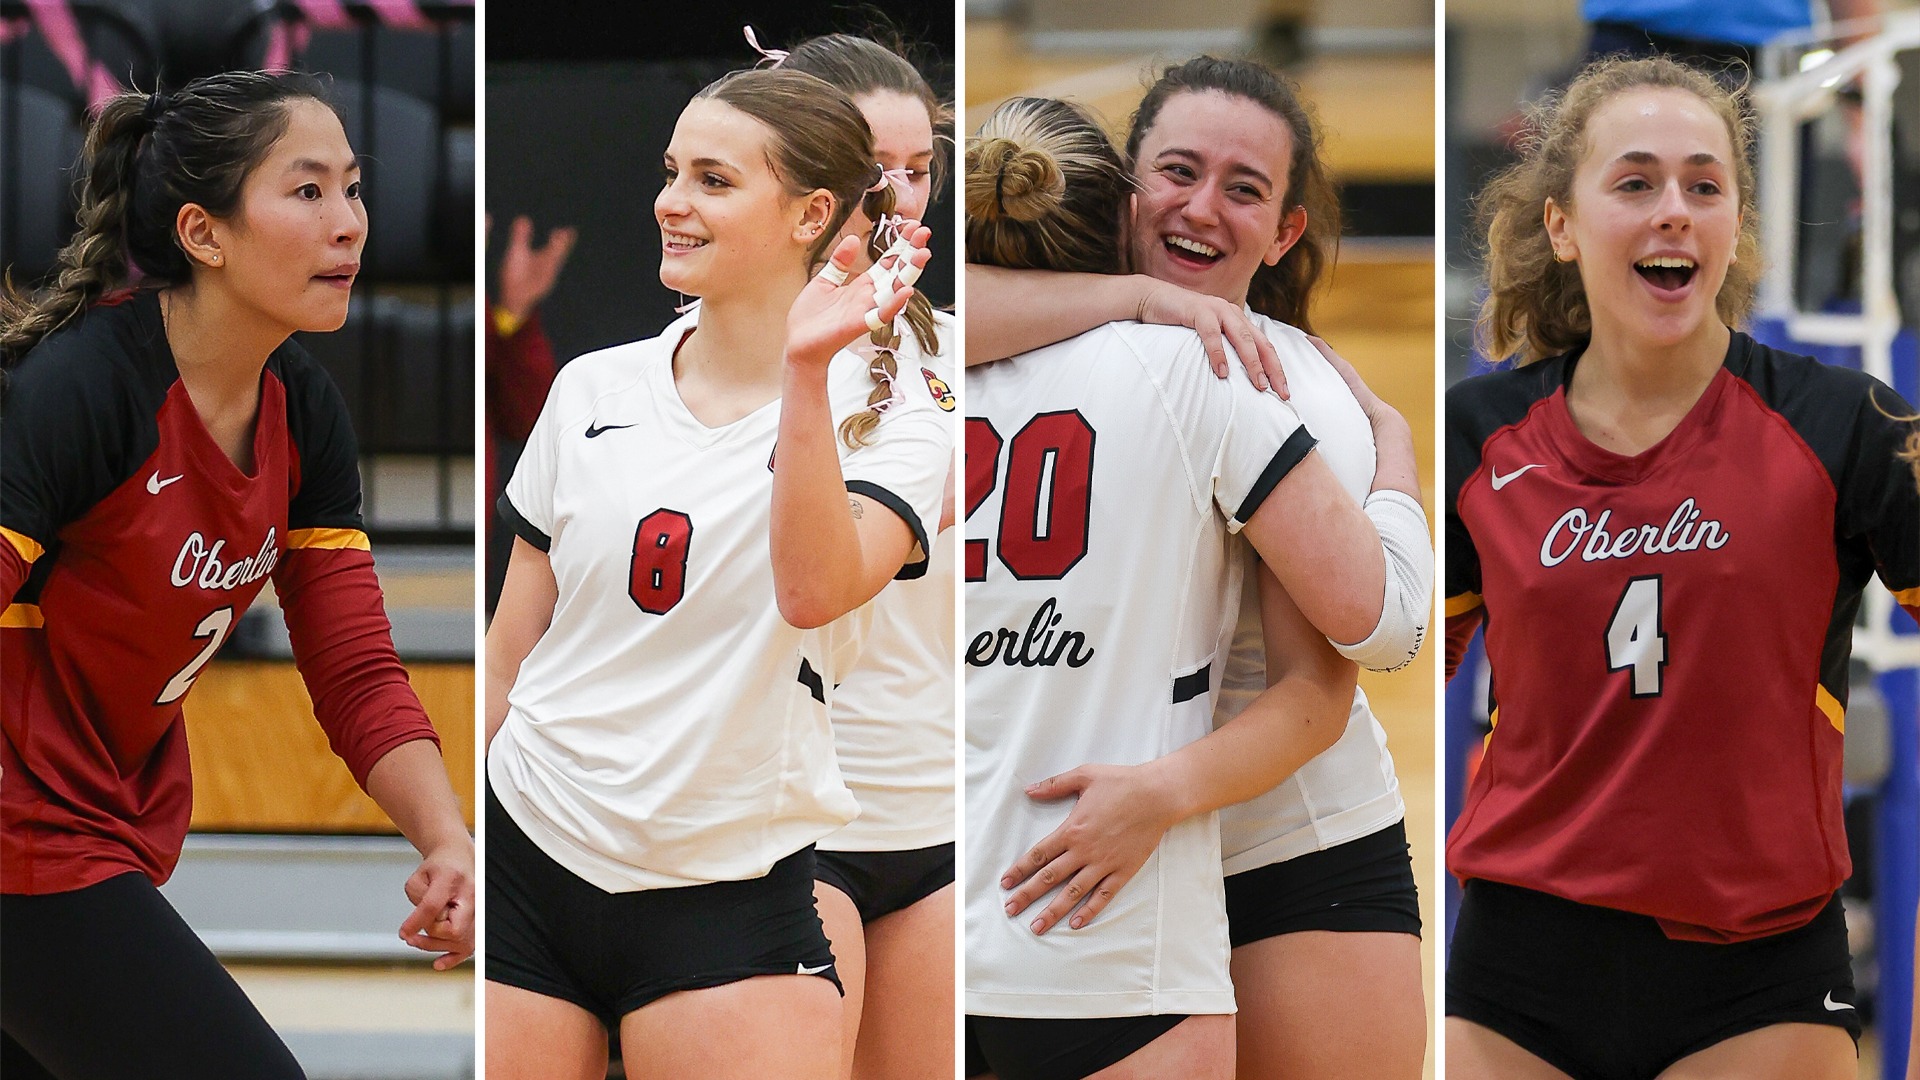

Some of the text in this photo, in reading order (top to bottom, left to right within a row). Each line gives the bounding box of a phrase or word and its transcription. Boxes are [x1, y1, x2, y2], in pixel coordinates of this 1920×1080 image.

[170, 526, 278, 590] Oberlin
[628, 507, 694, 616] 8
[1539, 497, 1730, 567] Oberlin
[153, 605, 233, 709] 2
[1603, 573, 1668, 699] 4
